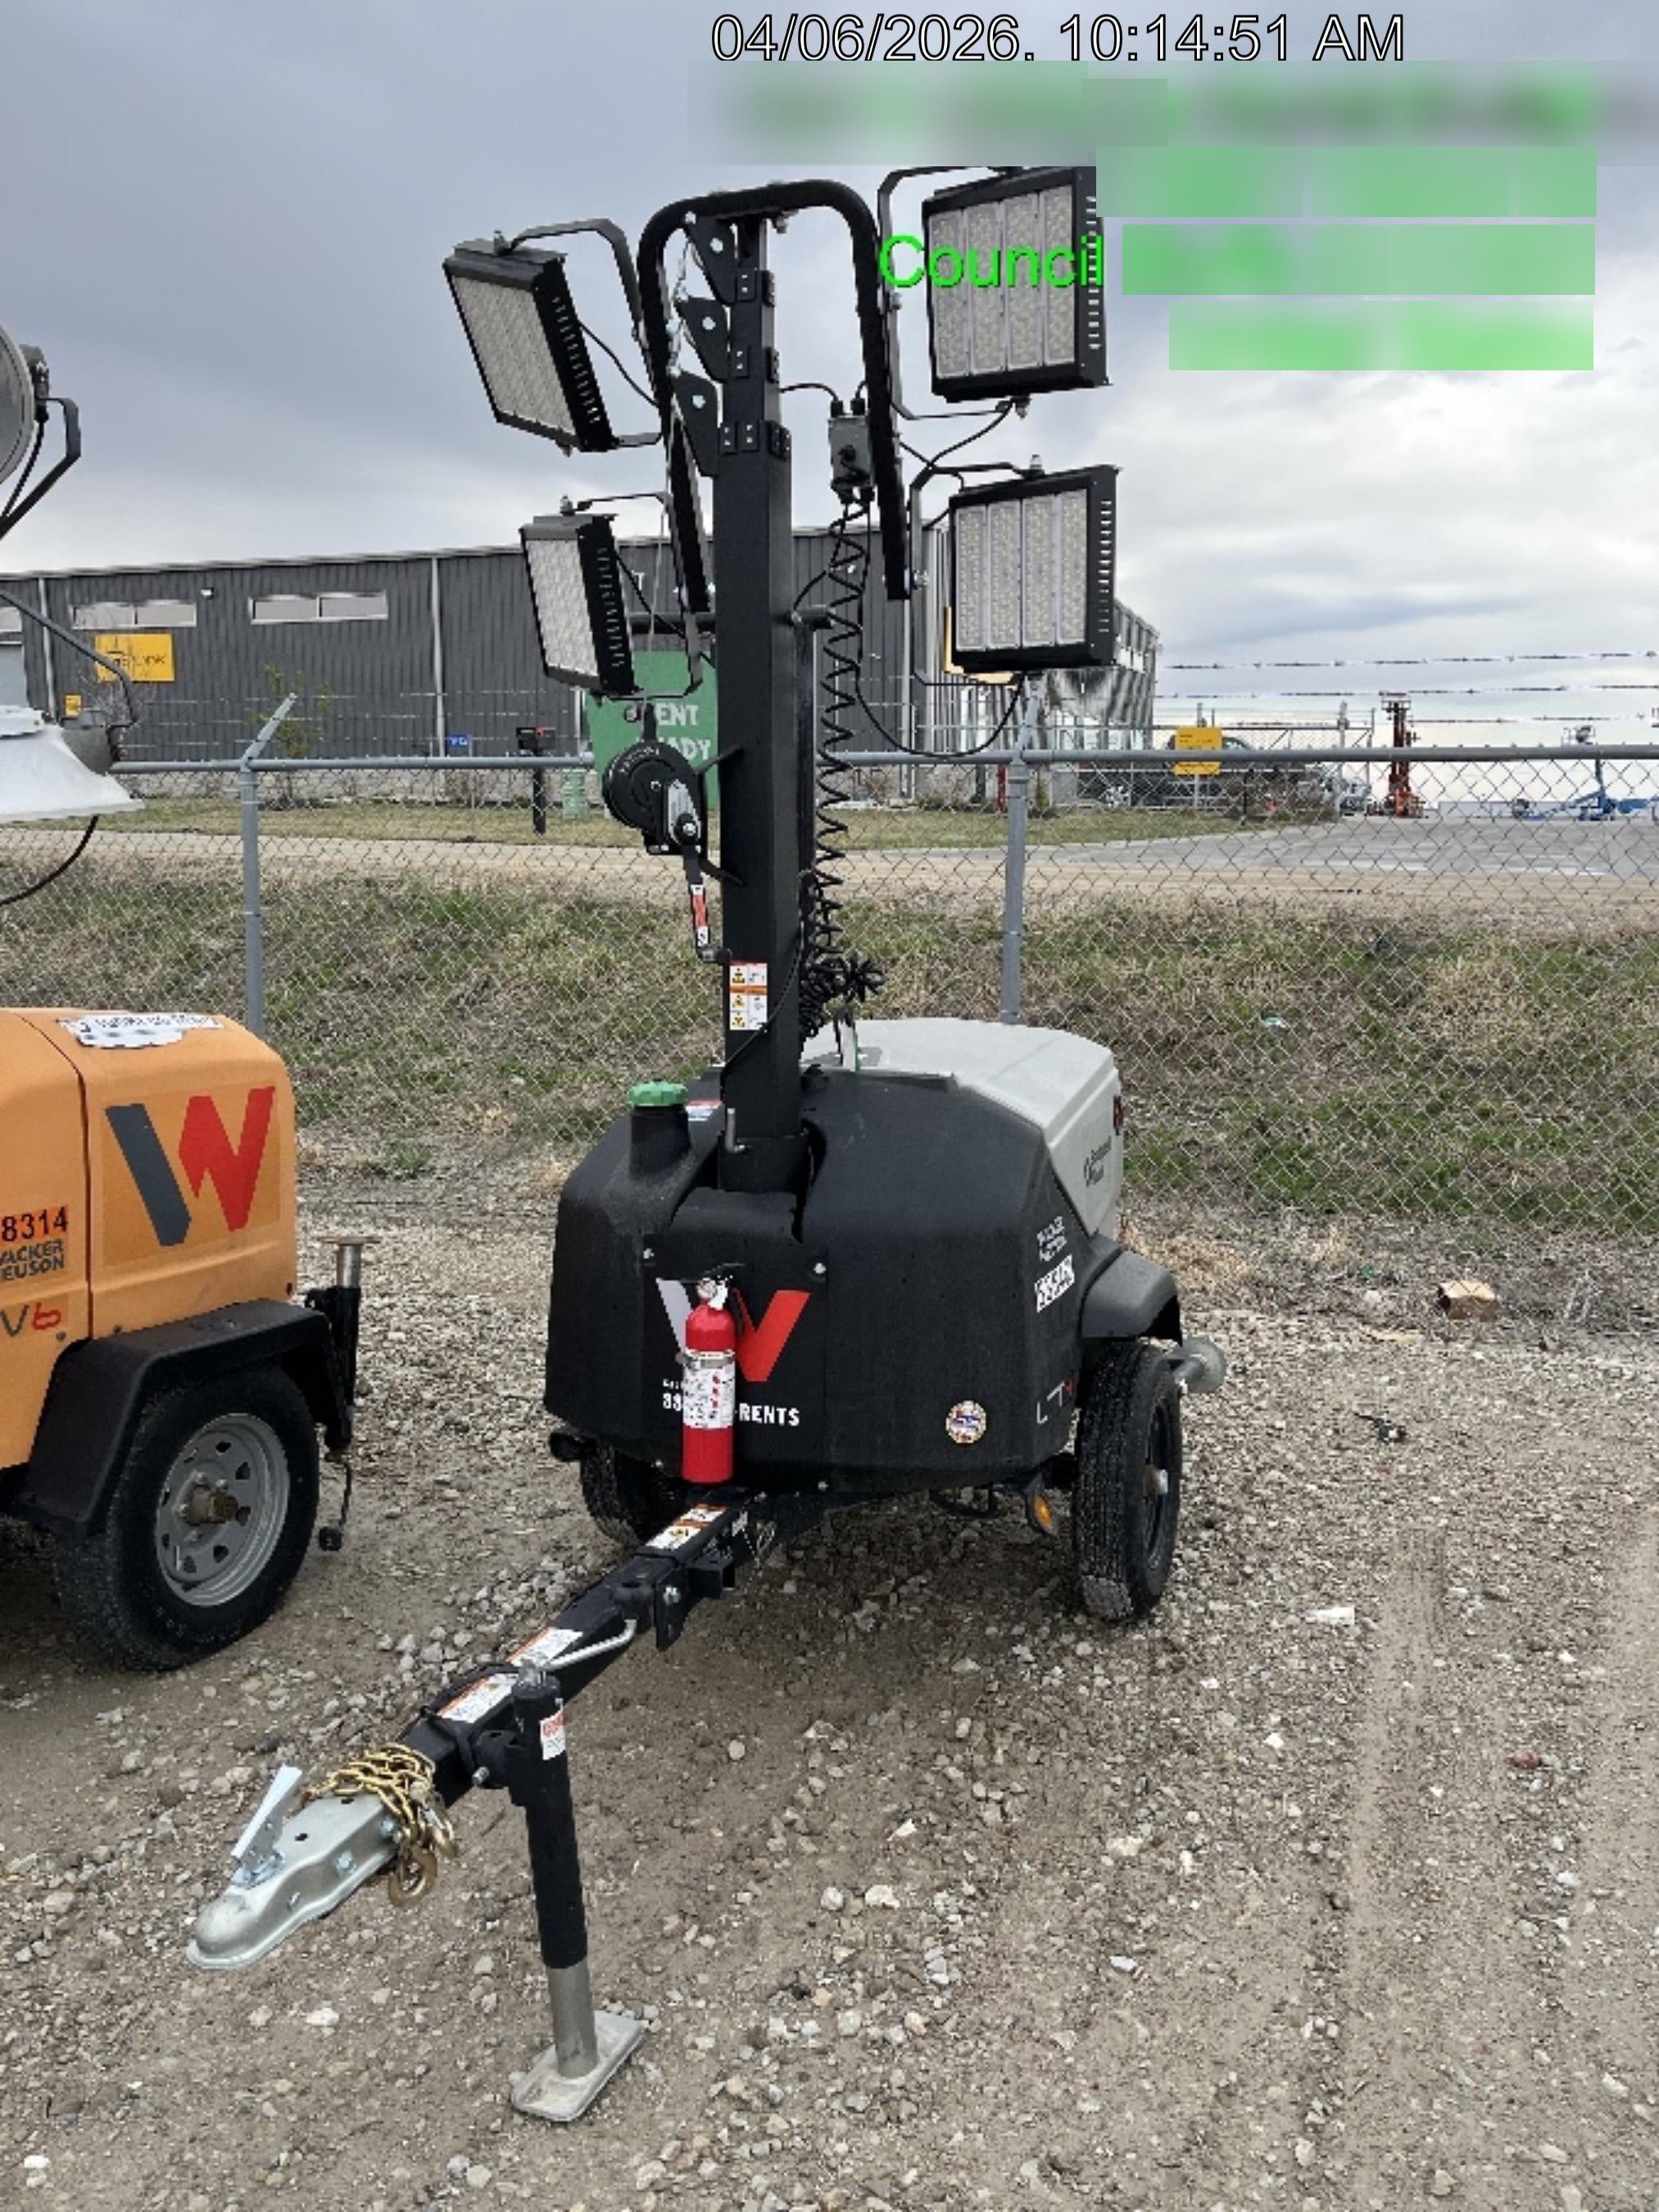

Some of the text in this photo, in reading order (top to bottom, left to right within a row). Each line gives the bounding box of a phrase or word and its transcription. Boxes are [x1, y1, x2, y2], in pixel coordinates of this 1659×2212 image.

[655, 703, 698, 726] ENT
[2, 1206, 68, 1242] 8314
[0, 1254, 64, 1281] EUSON
